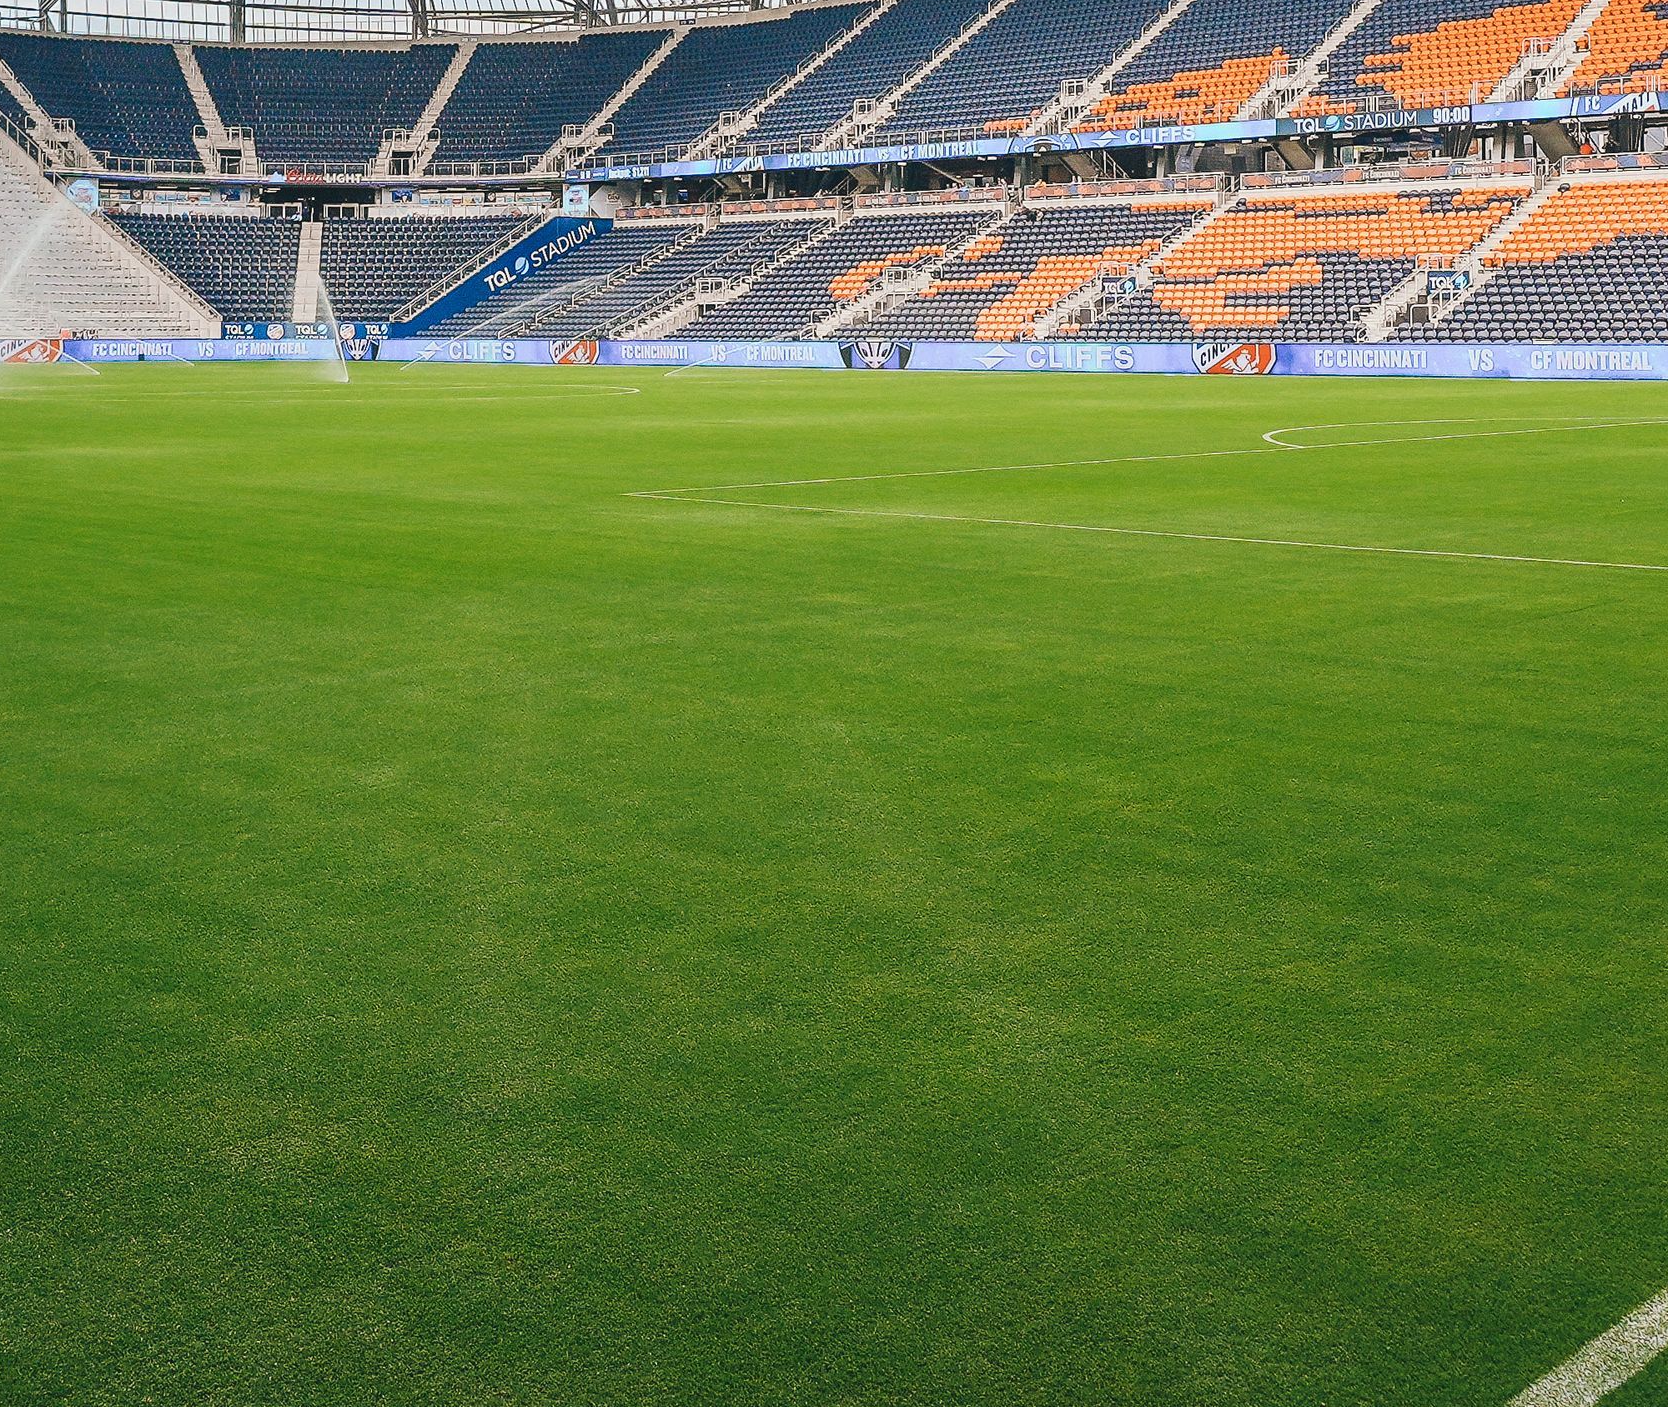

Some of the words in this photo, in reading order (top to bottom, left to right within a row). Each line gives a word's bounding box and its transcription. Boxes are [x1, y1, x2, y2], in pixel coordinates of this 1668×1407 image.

[1585, 96, 1601, 113] FC
[1294, 119, 1325, 133] TQL
[1344, 111, 1418, 131] STADIUM
[1433, 106, 1469, 124] 90:00
[1125, 126, 1196, 145] CLIFFS
[788, 154, 801, 167] FC
[803, 150, 864, 166] CINCINNATI
[878, 149, 889, 159] VS
[901, 147, 915, 159] CF
[918, 143, 979, 158] MONTREAL
[326, 172, 363, 183] LIGHT
[484, 267, 517, 291] TQL
[531, 221, 596, 267] STADIUM
[225, 325, 244, 335] TQL
[295, 325, 318, 335] TQL
[365, 325, 383, 335] TQL
[92, 344, 107, 357] FC
[109, 343, 172, 357] CINCINNATI
[197, 344, 214, 358] VS
[235, 344, 249, 356] CF
[250, 343, 308, 356] MONTREAL
[449, 341, 515, 361] CLIFFS
[621, 345, 633, 359] FC
[634, 345, 688, 360] CINCINNATI
[711, 346, 726, 362] VS
[746, 345, 759, 360] CF
[760, 345, 815, 361] MONTREAL
[1026, 345, 1134, 370] CLIFFS
[1314, 349, 1333, 367] FC
[1336, 350, 1427, 369] CINCINNATI
[1468, 349, 1494, 372] VS
[1531, 350, 1552, 369] CF
[1556, 350, 1653, 371] MONTREAL
